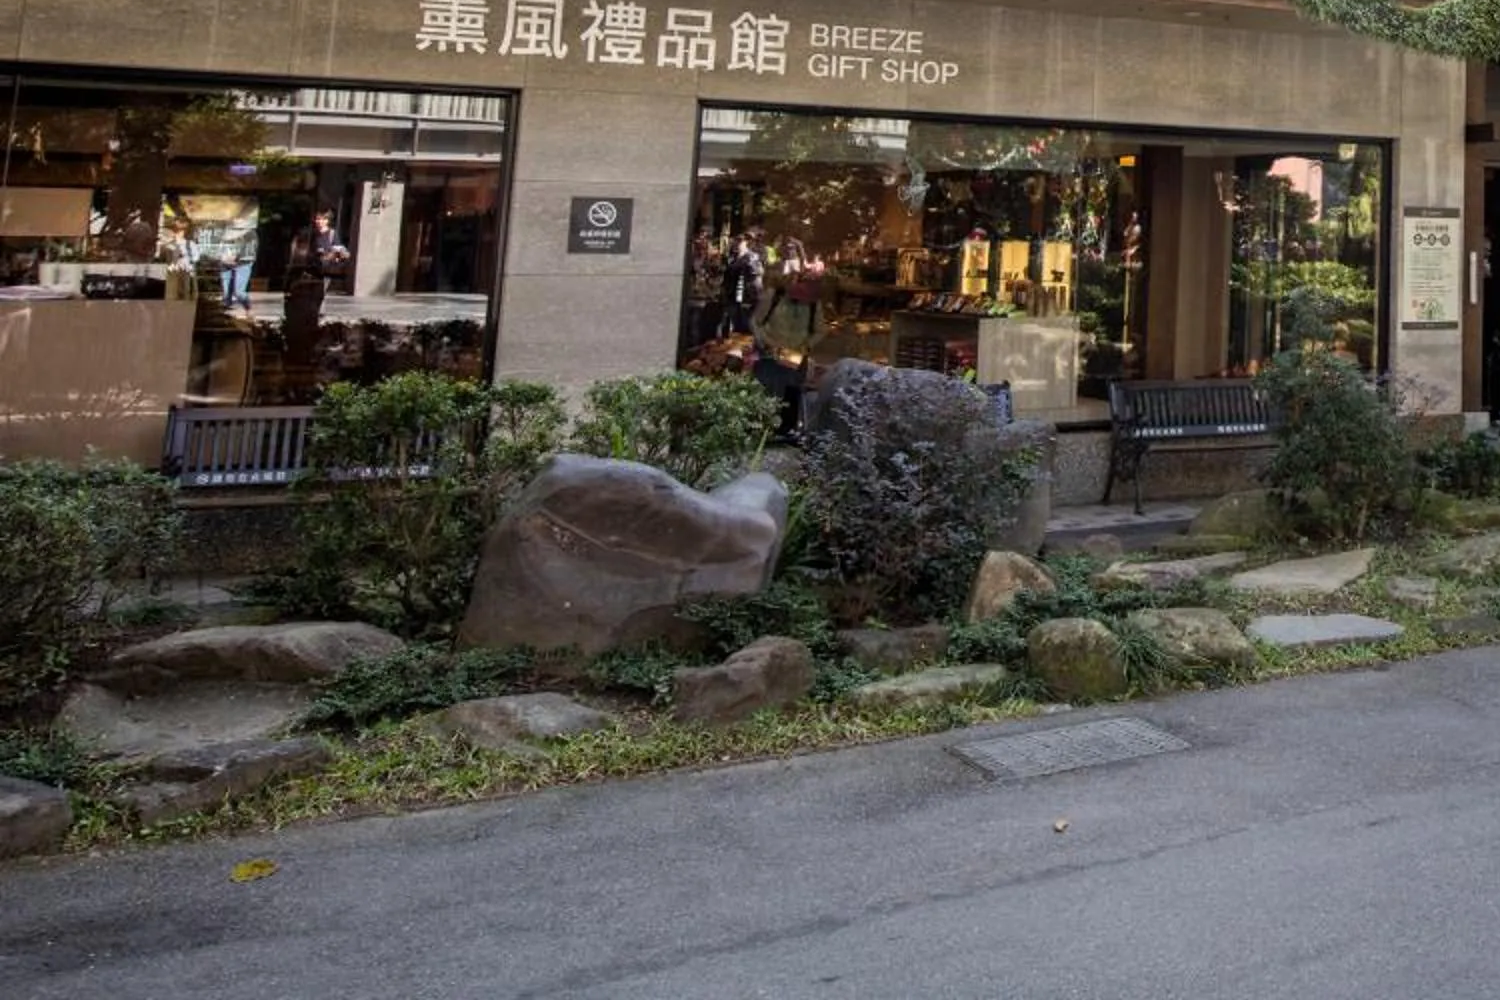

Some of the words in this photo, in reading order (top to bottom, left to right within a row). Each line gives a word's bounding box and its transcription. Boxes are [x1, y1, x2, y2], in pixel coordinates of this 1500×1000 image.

[809, 24, 923, 54] BREEZE
[807, 54, 871, 80] GIFT
[880, 61, 960, 85] SHOP
